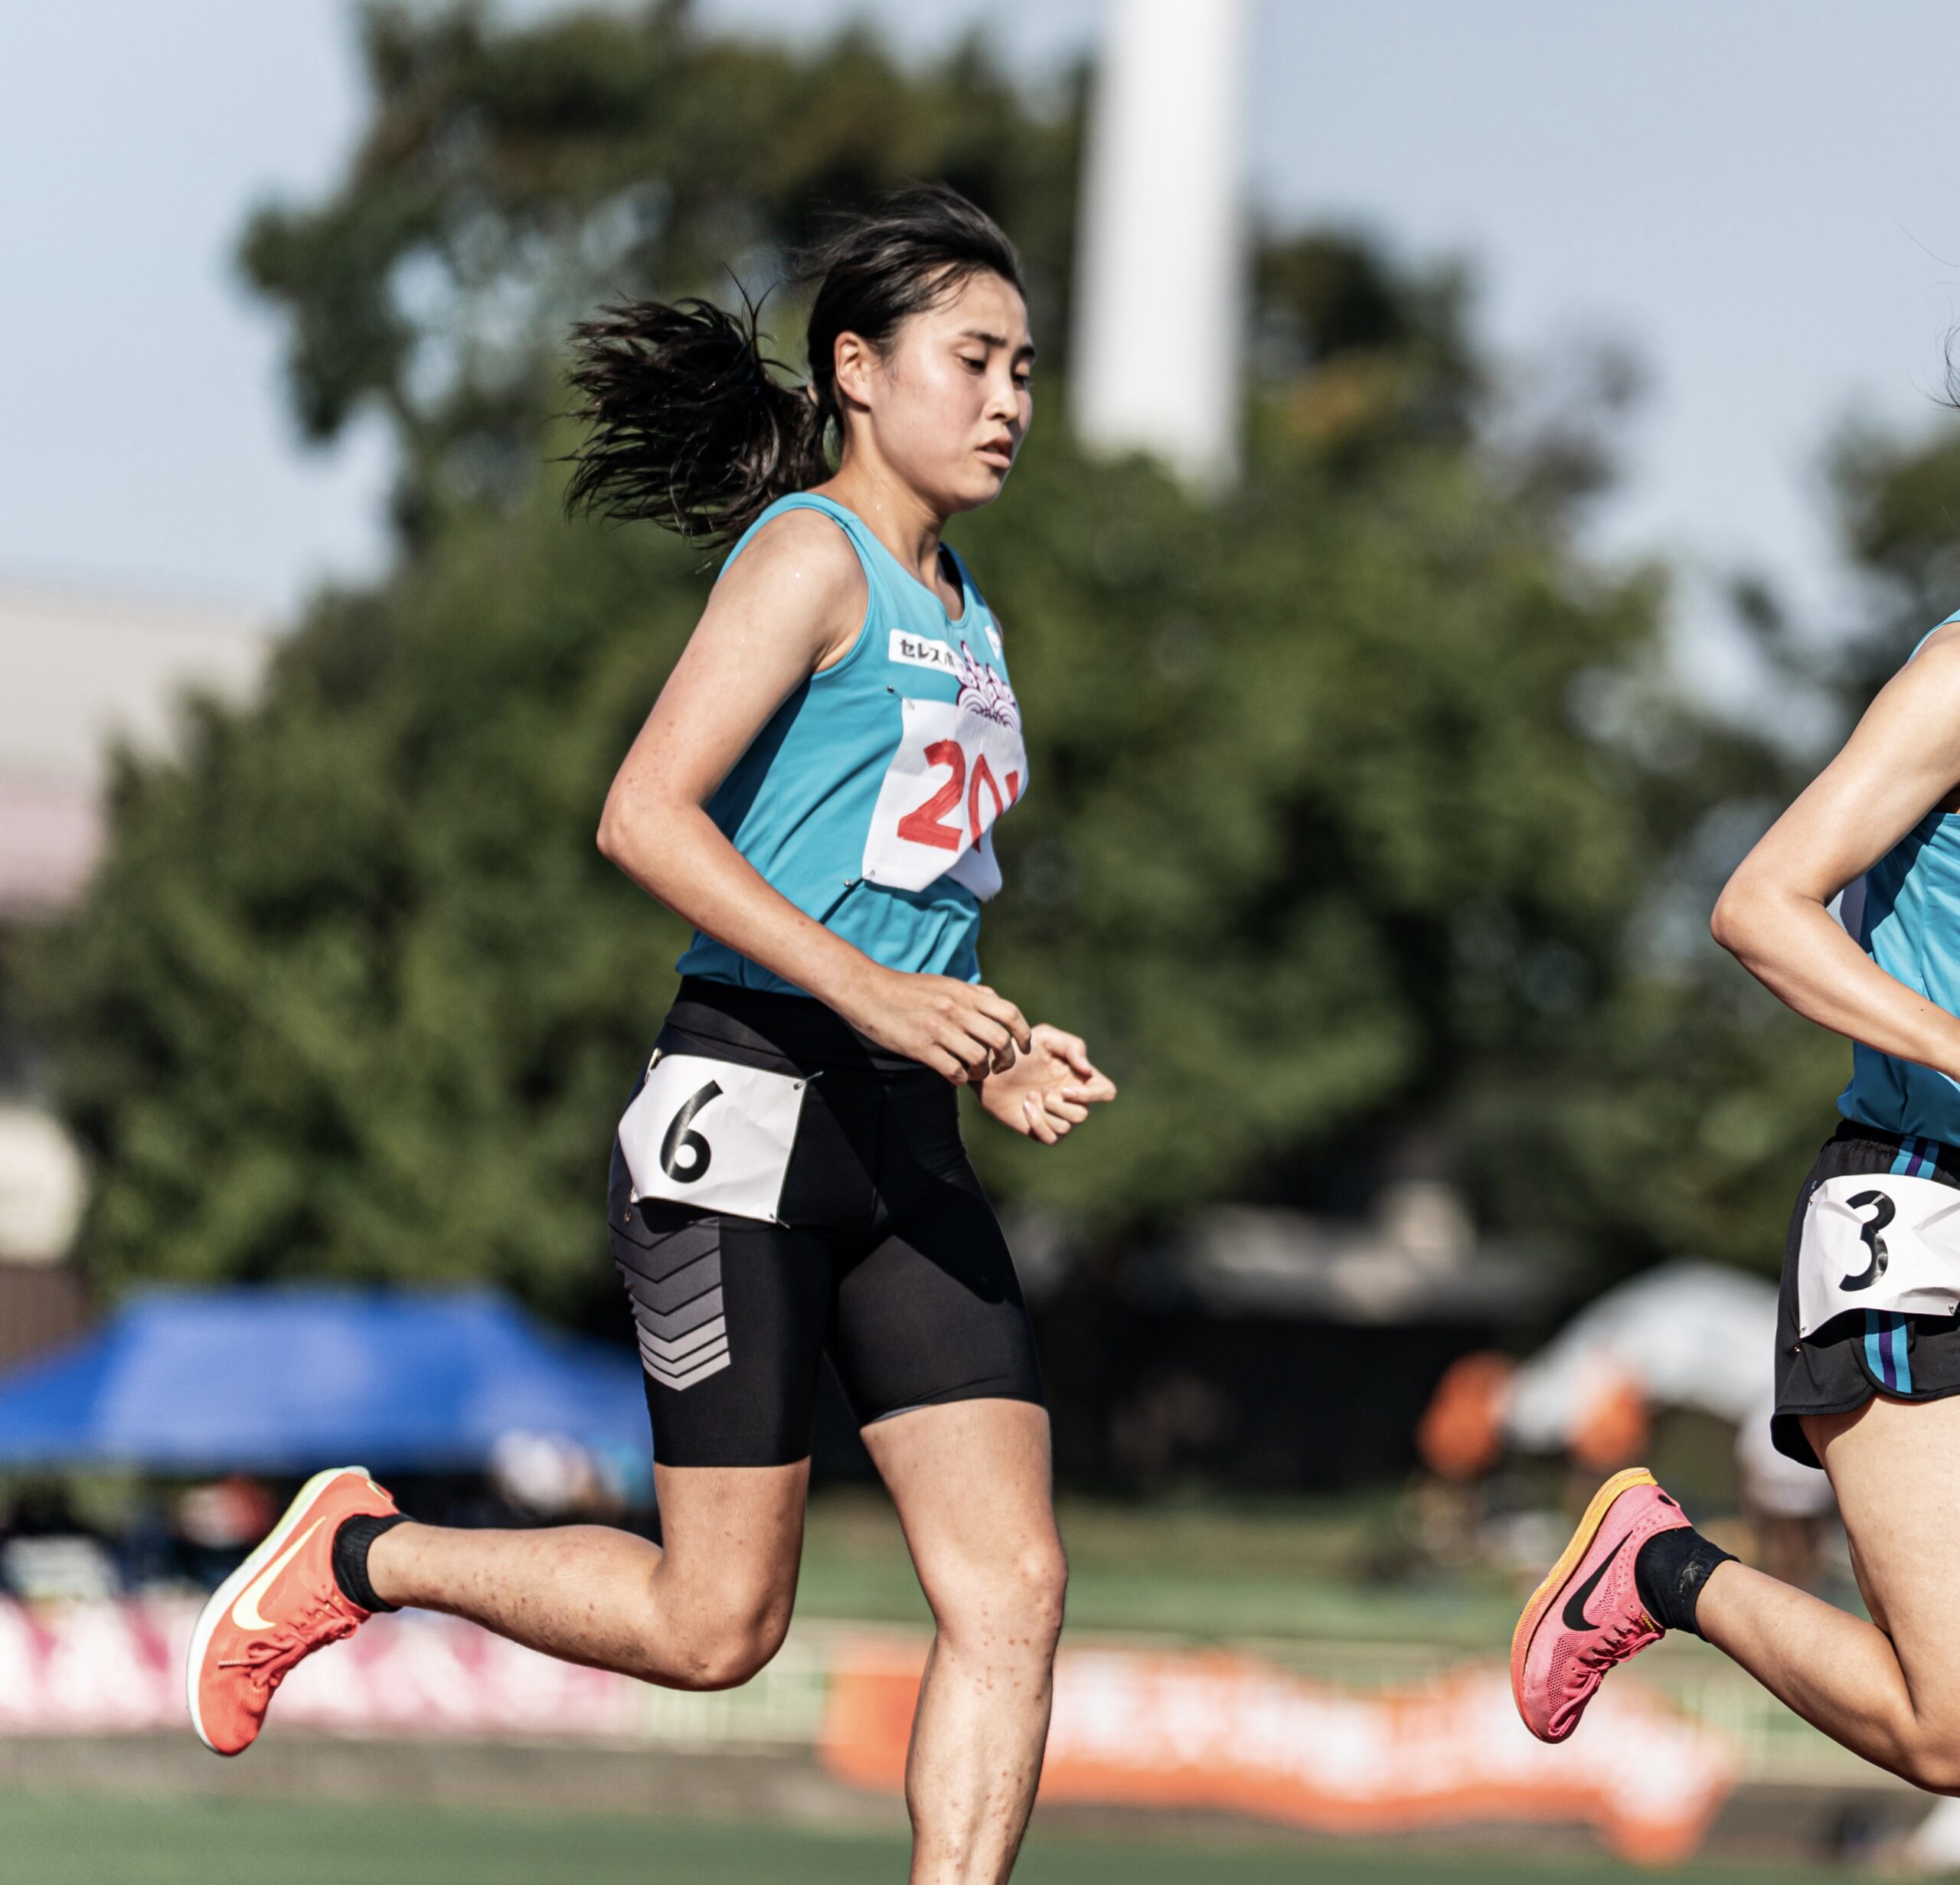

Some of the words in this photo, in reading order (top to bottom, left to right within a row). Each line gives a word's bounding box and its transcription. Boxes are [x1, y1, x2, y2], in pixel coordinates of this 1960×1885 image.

[897, 740, 1018, 852] 20
[660, 1080, 724, 1184] 6
[1839, 1190, 1896, 1292] 3
